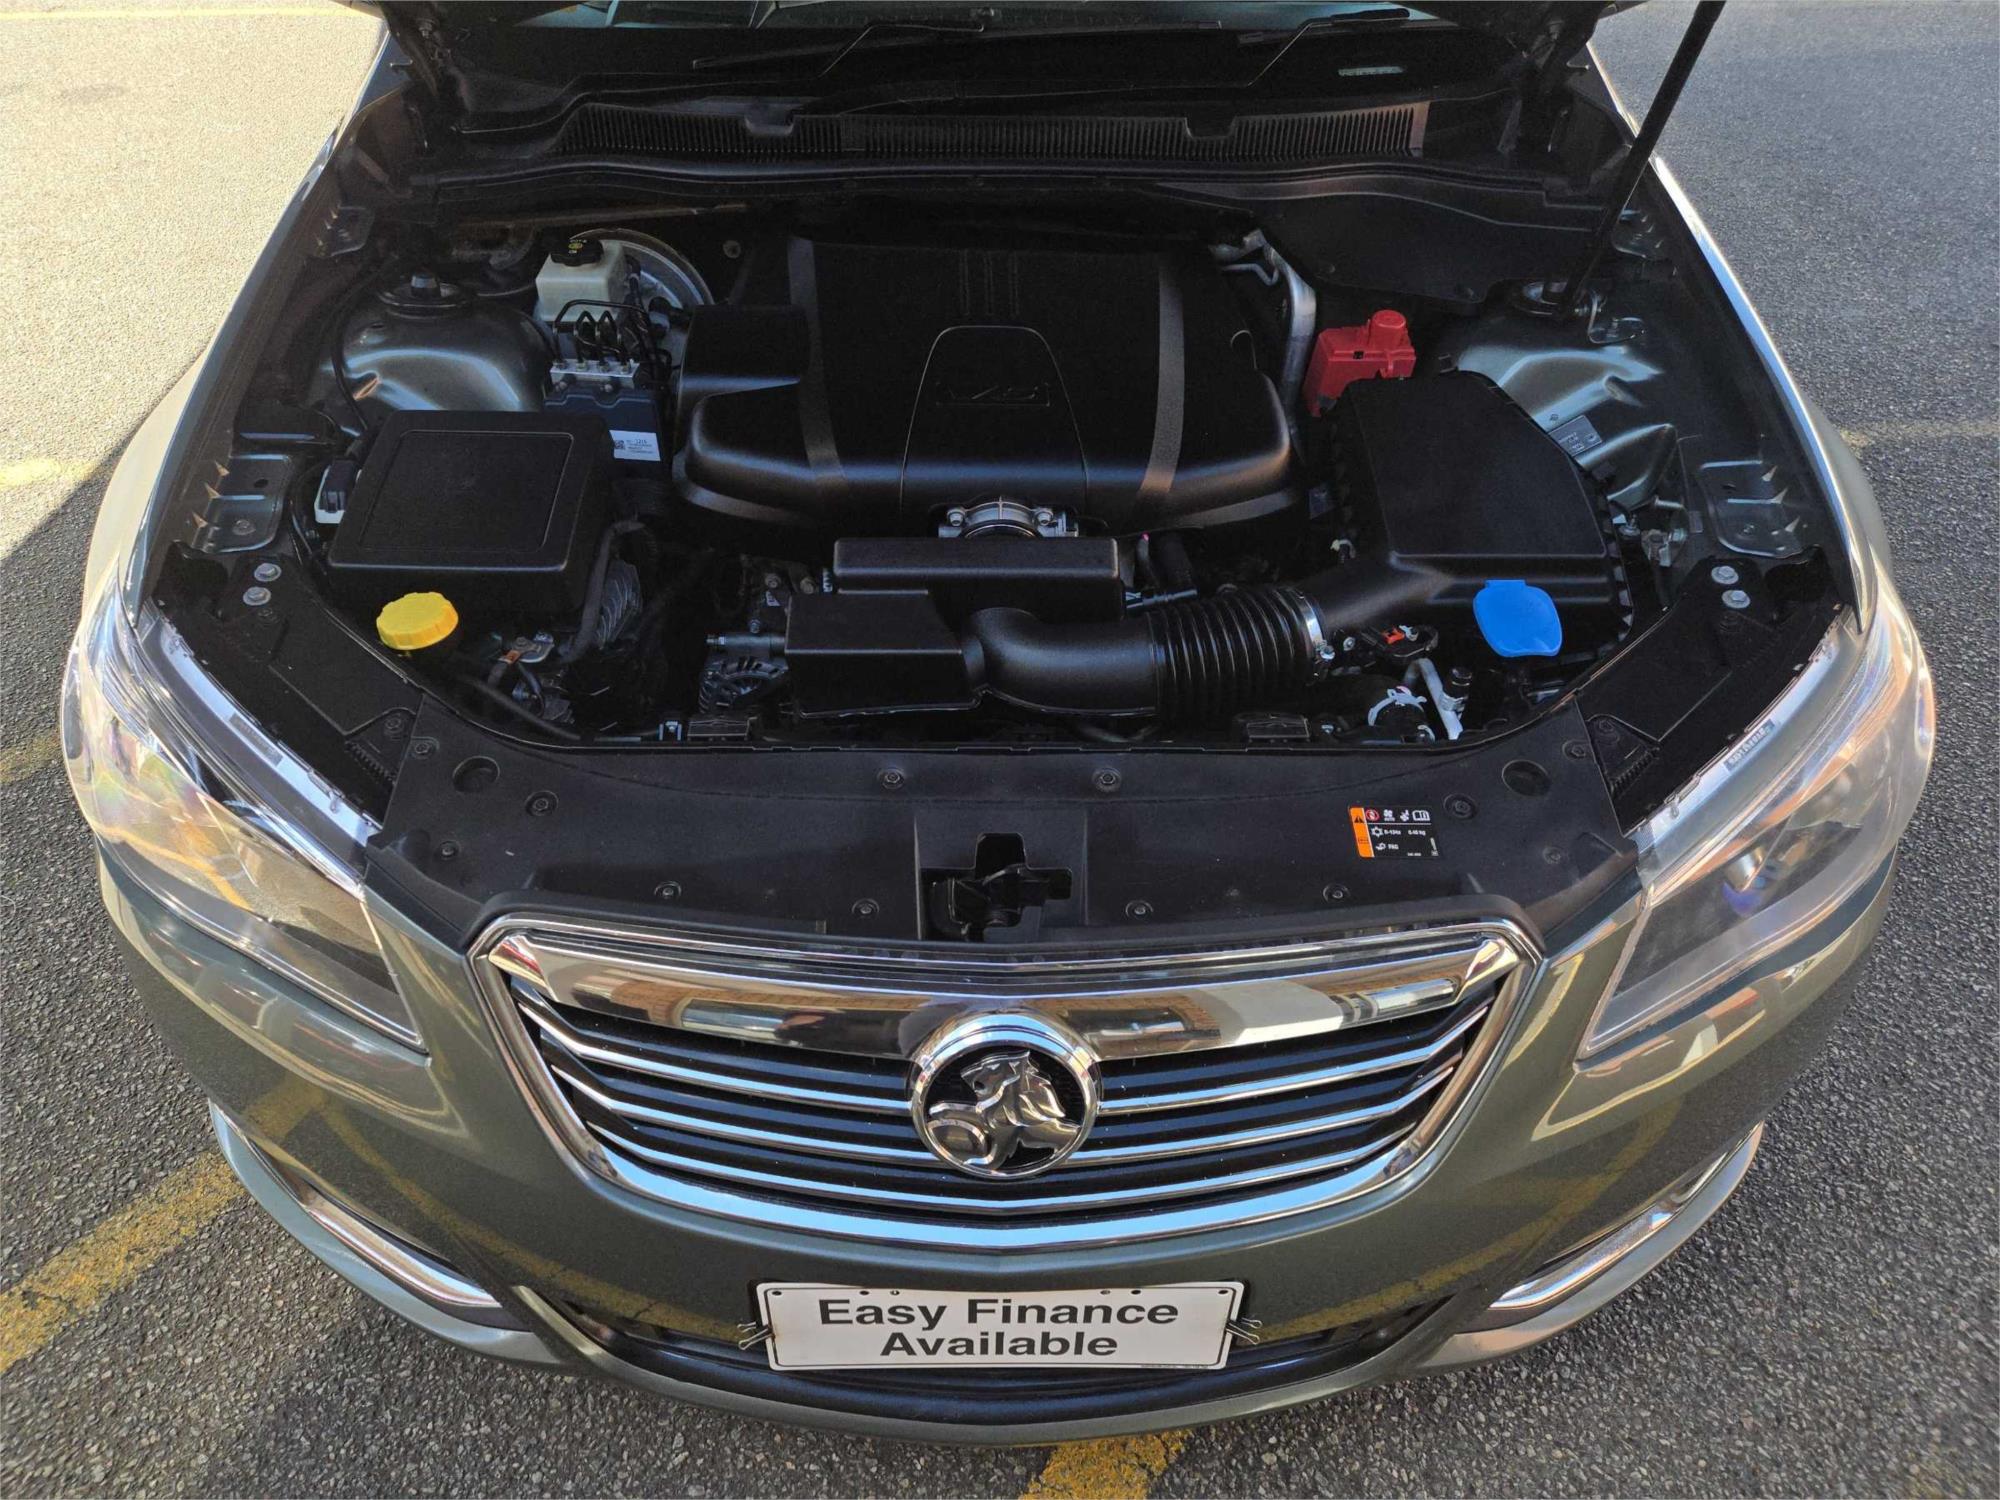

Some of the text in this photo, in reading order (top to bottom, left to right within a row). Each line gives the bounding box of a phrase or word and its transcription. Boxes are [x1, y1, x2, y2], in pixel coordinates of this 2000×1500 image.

[818, 1298, 1179, 1331] Easy Finance
[880, 1331, 1118, 1356] Available
